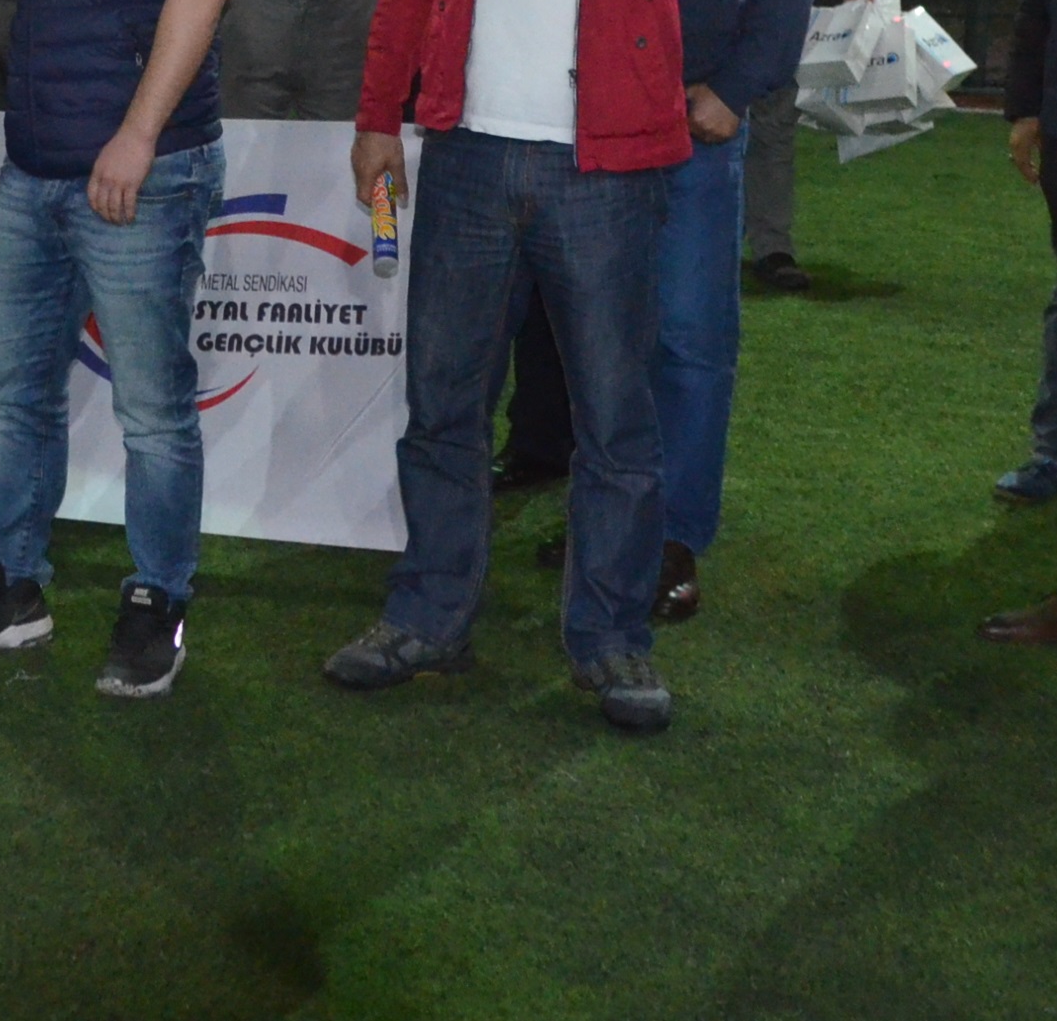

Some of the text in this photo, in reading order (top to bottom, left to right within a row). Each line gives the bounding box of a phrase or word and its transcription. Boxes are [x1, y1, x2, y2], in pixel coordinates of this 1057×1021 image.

[200, 271, 309, 293] METAL SENDİKASI
[193, 298, 368, 326] SYAL FAALİYET
[196, 330, 404, 358] GENÇLİK KULÜBÜ
